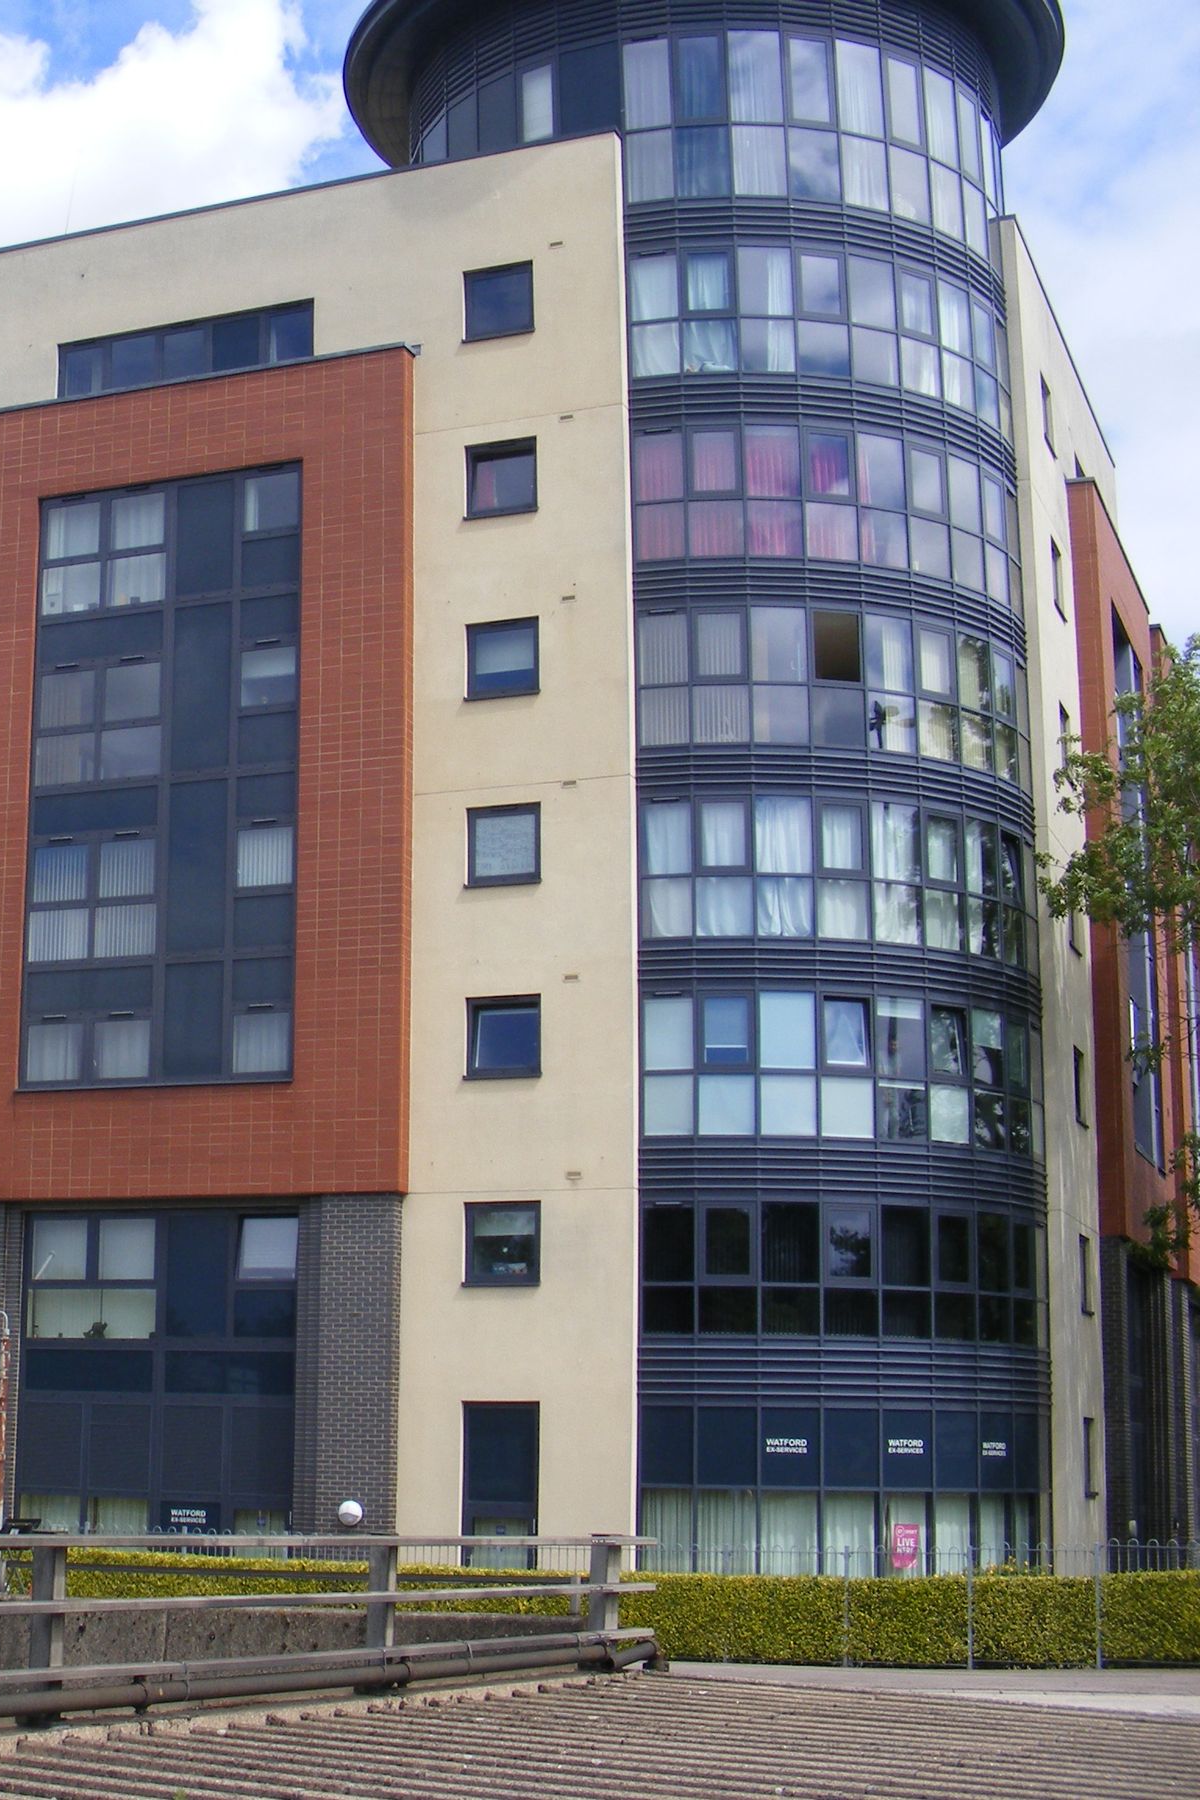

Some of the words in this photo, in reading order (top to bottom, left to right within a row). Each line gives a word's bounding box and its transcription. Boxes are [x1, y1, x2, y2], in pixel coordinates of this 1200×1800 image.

[765, 1438, 808, 1447] WATFORD
[888, 1439, 924, 1448] WATFORD
[982, 1441, 1007, 1450] WATFORD
[766, 1446, 808, 1454] EX-SERVICES
[170, 1509, 207, 1518] WATFORD
[897, 1537, 916, 1547] LIVE
